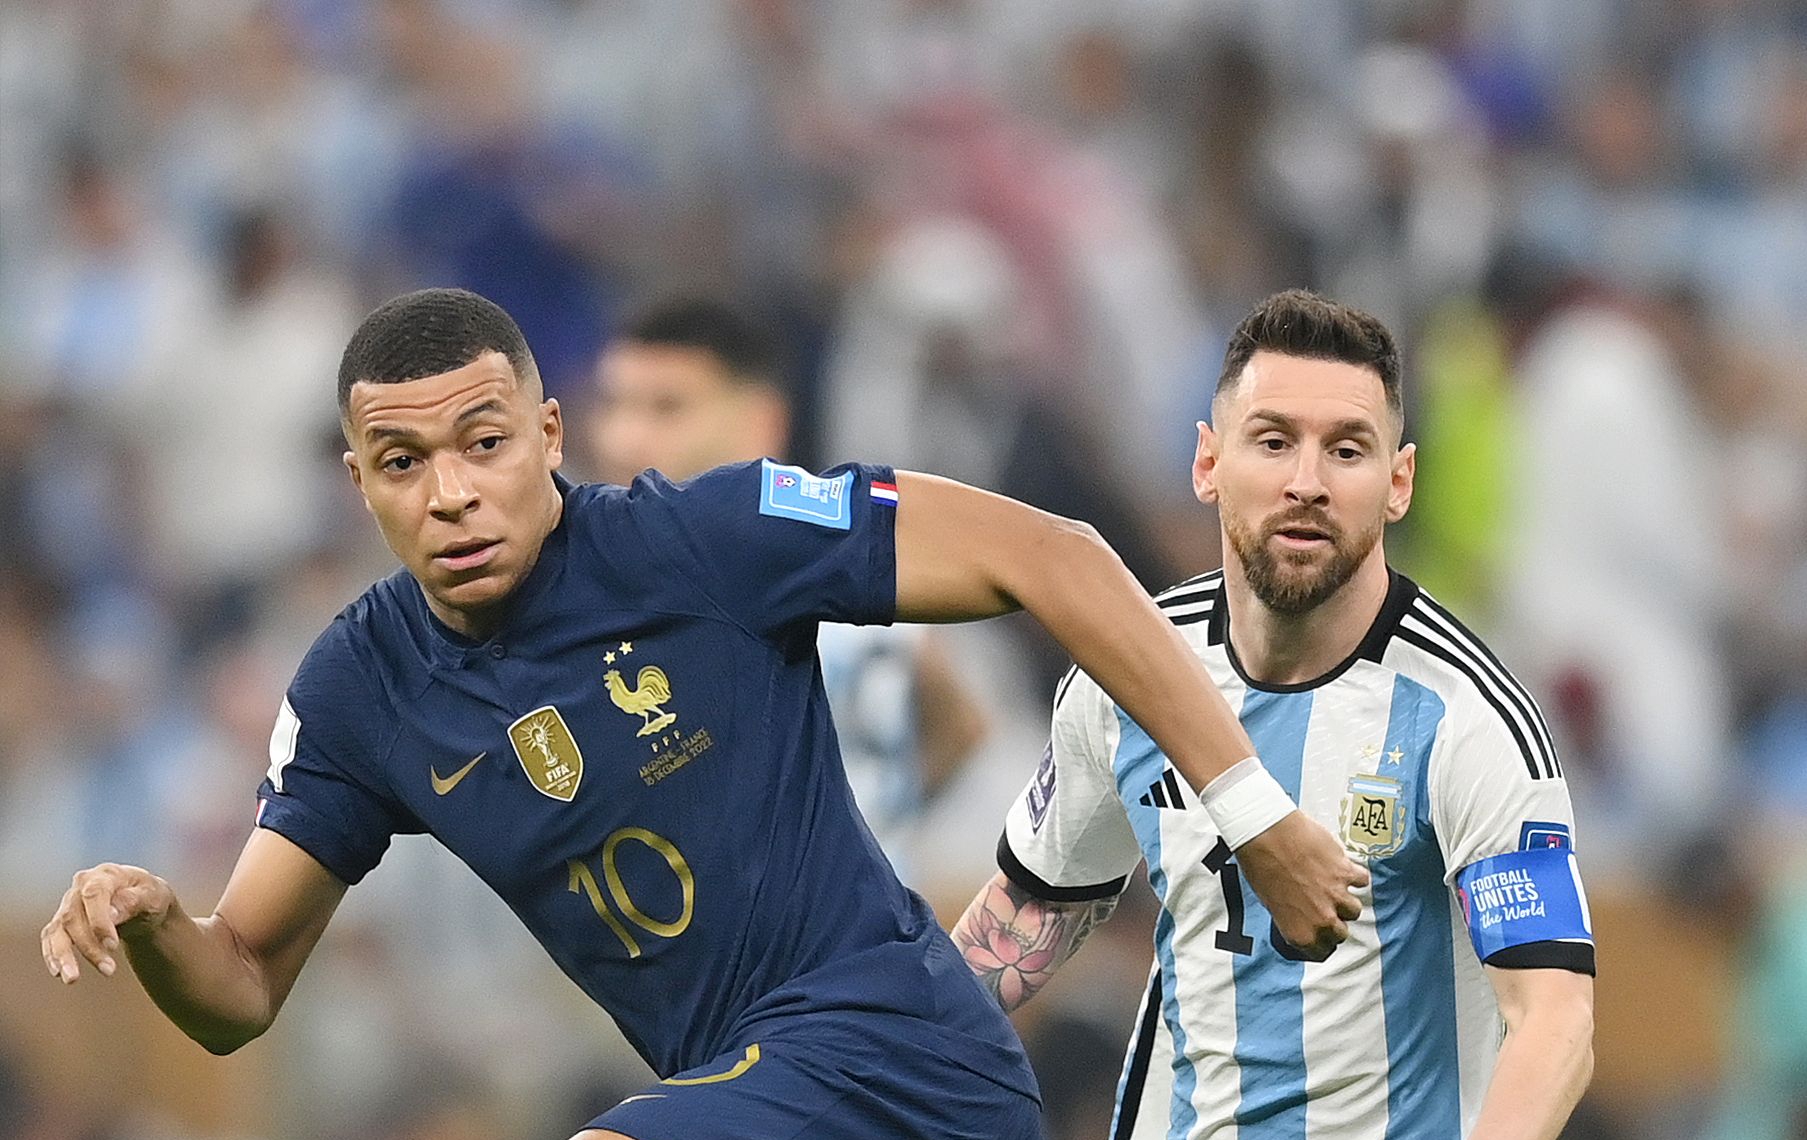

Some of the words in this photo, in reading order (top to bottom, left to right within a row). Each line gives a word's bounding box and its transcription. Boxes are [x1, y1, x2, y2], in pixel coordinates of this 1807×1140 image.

[1352, 796, 1389, 836] AFA
[565, 826, 695, 959] 10
[1201, 835, 1338, 963] 1
[1470, 868, 1533, 896] FOOTBALL
[1474, 882, 1539, 913] UNITES
[1479, 911, 1503, 929] the
[1502, 901, 1546, 922] World
